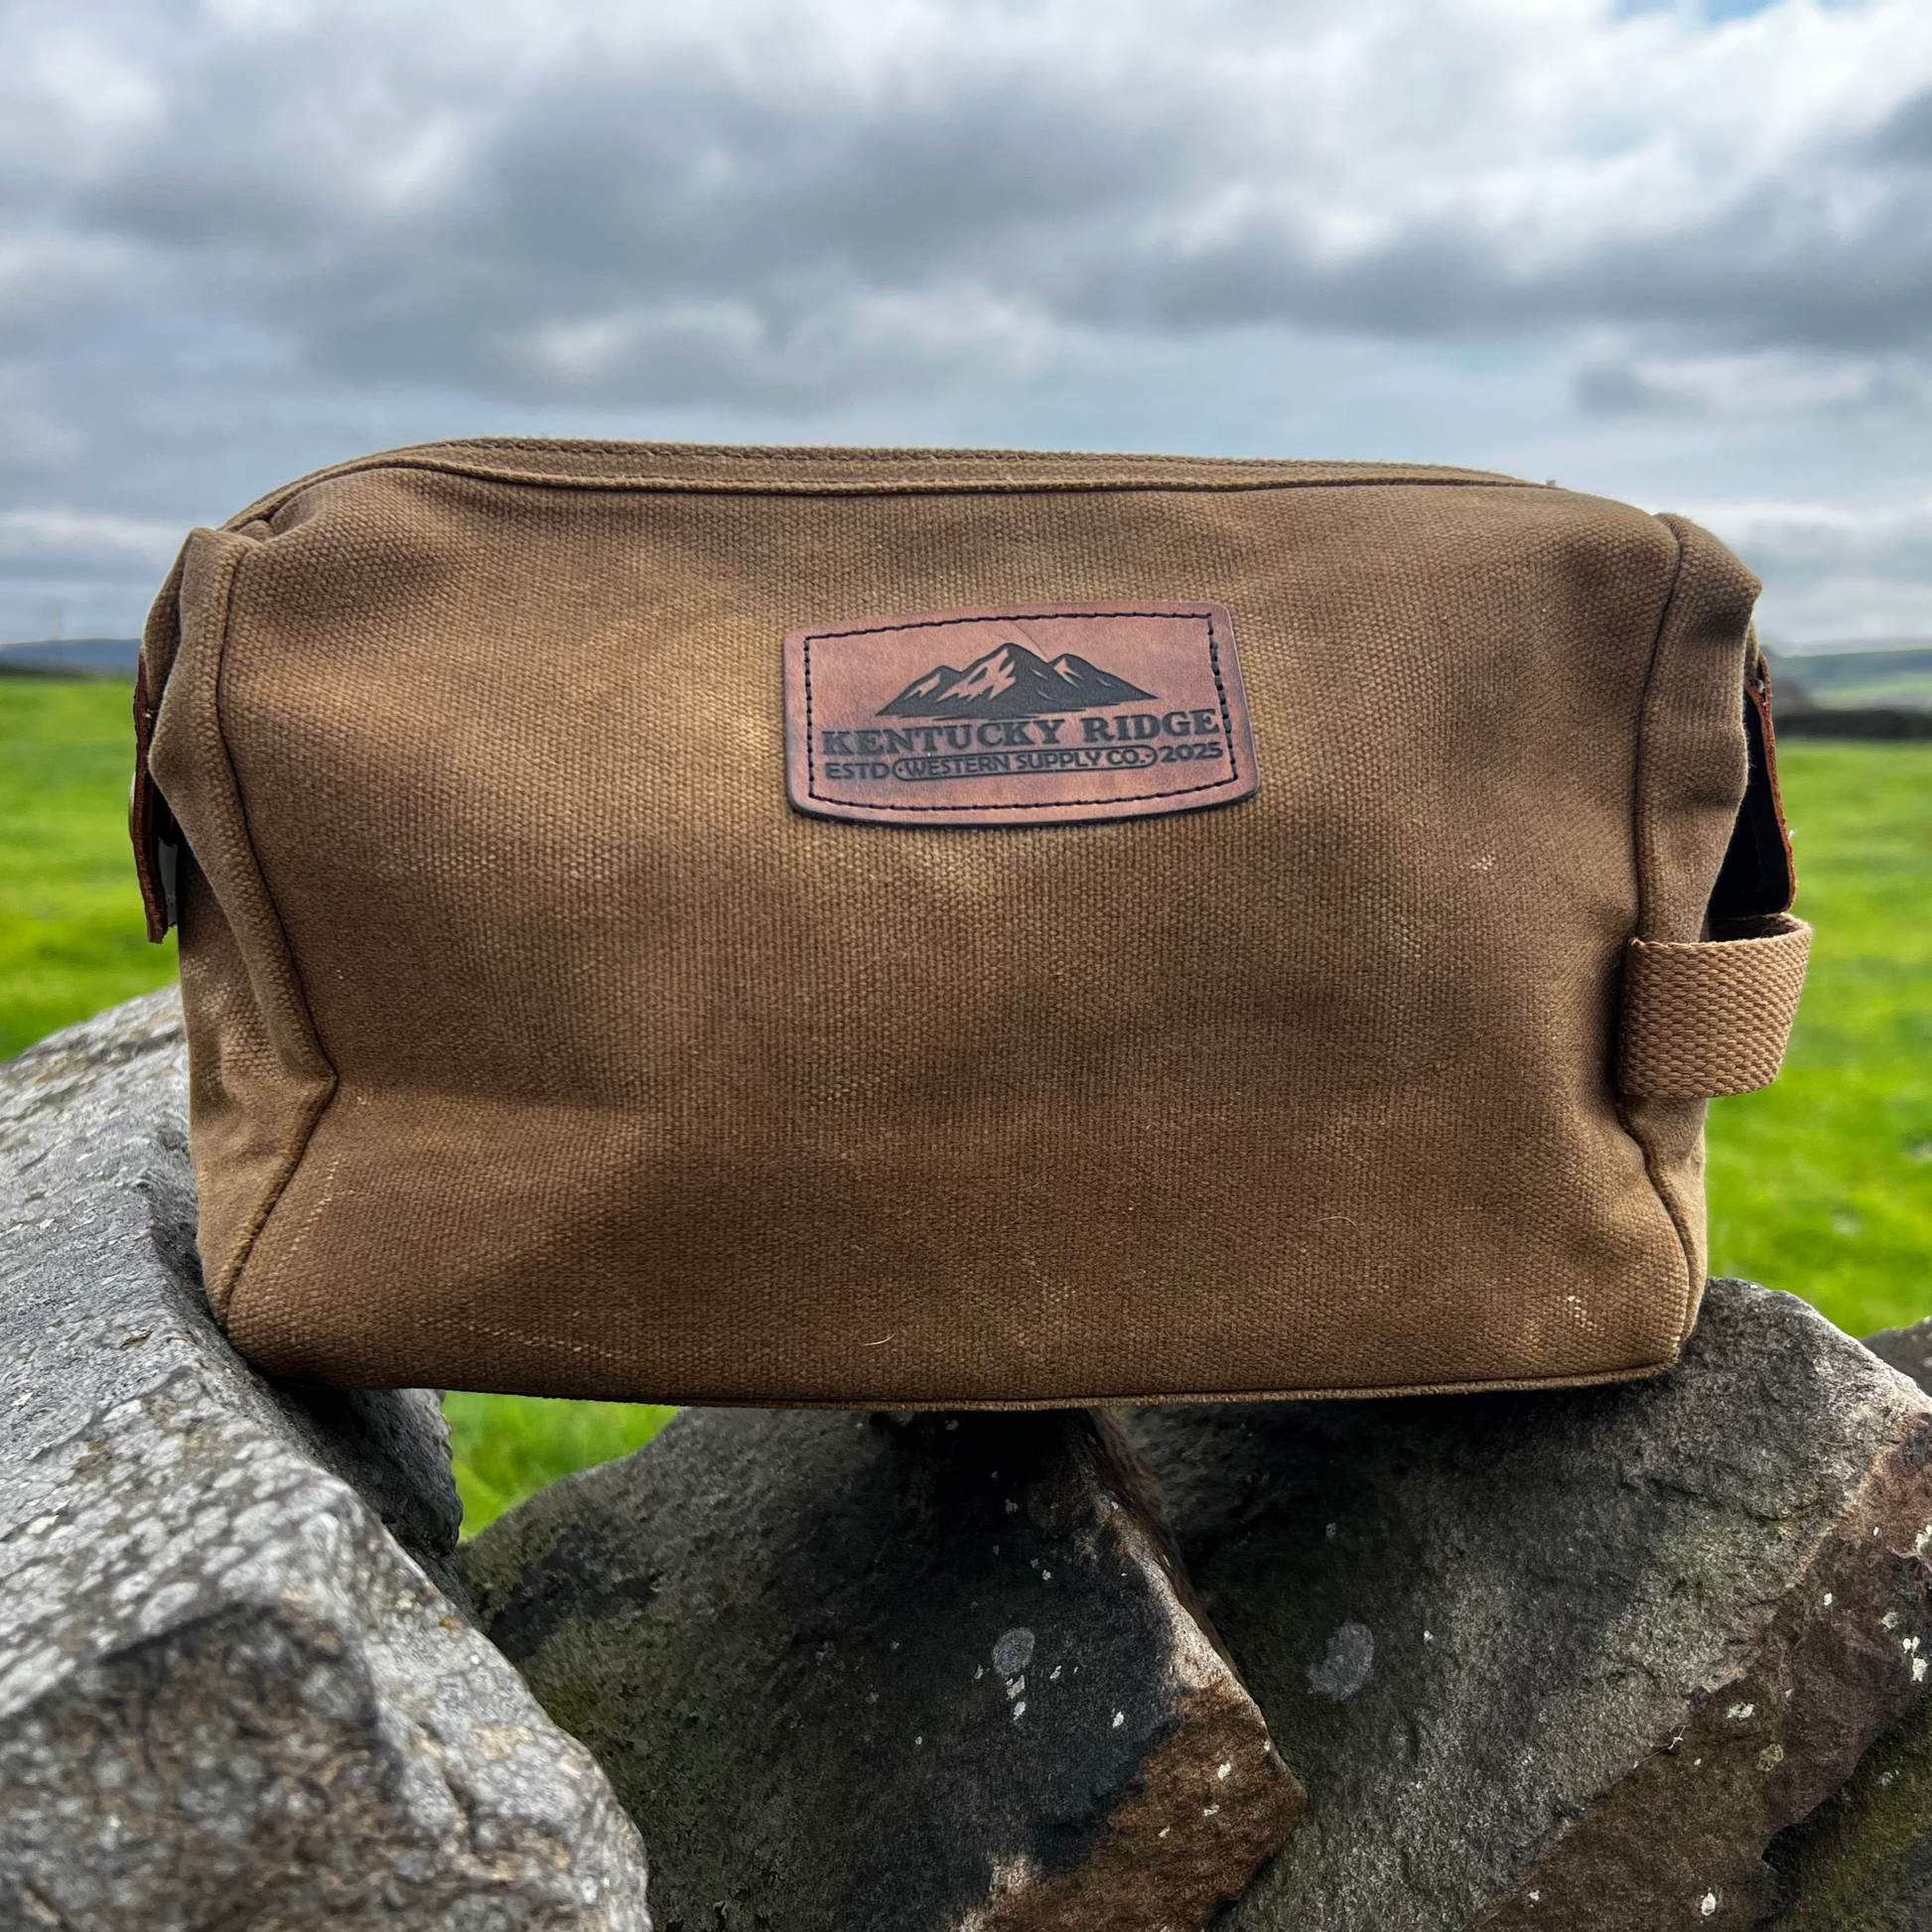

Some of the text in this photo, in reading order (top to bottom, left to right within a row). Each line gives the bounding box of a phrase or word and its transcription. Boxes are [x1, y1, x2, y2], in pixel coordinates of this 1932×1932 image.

[822, 709, 1220, 755] KENTUCKY RIDGE
[904, 749, 1146, 777] WESTERN SUPPLY CO.
[1159, 742, 1223, 762] 2025
[825, 762, 890, 779] ESTD
